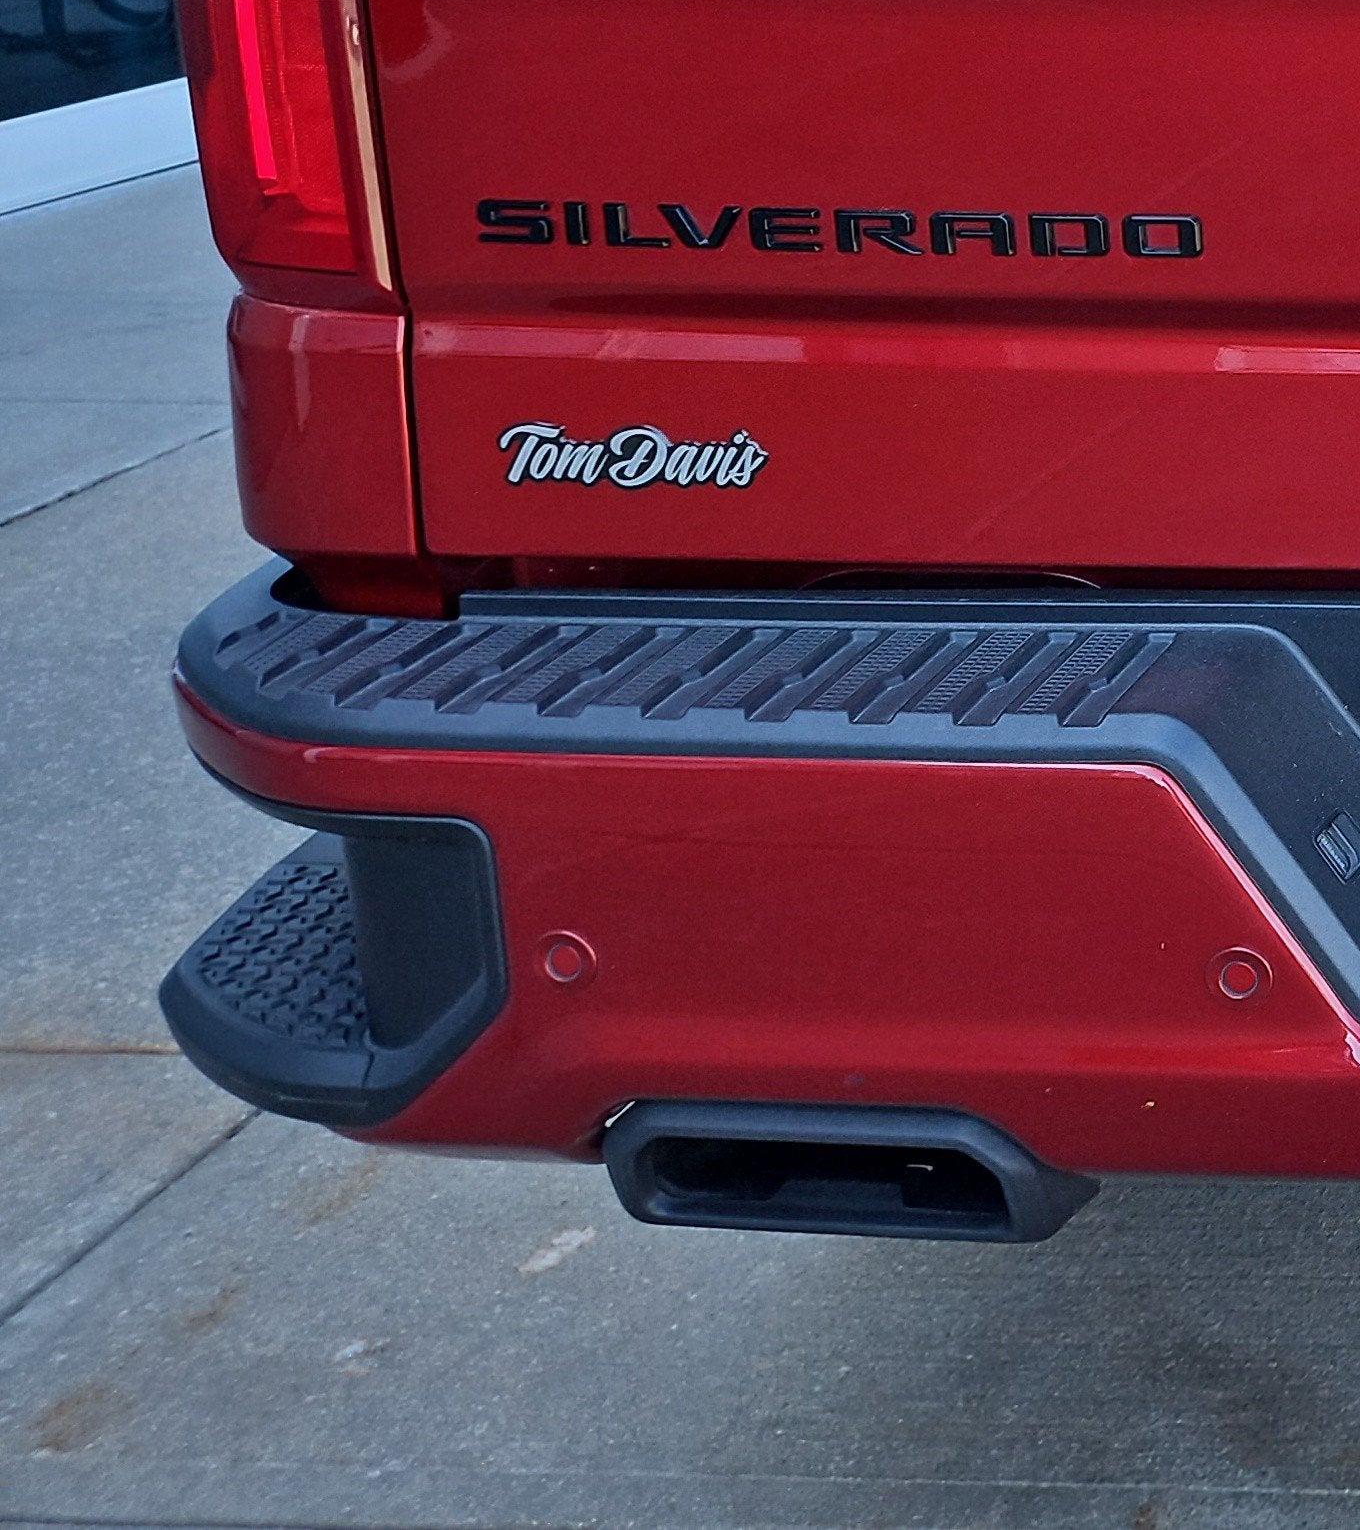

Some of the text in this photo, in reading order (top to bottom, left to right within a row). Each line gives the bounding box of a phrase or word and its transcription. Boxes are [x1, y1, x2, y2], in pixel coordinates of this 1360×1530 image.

[476, 198, 1203, 258] SILVERADO
[498, 421, 767, 488] Tom Davis
